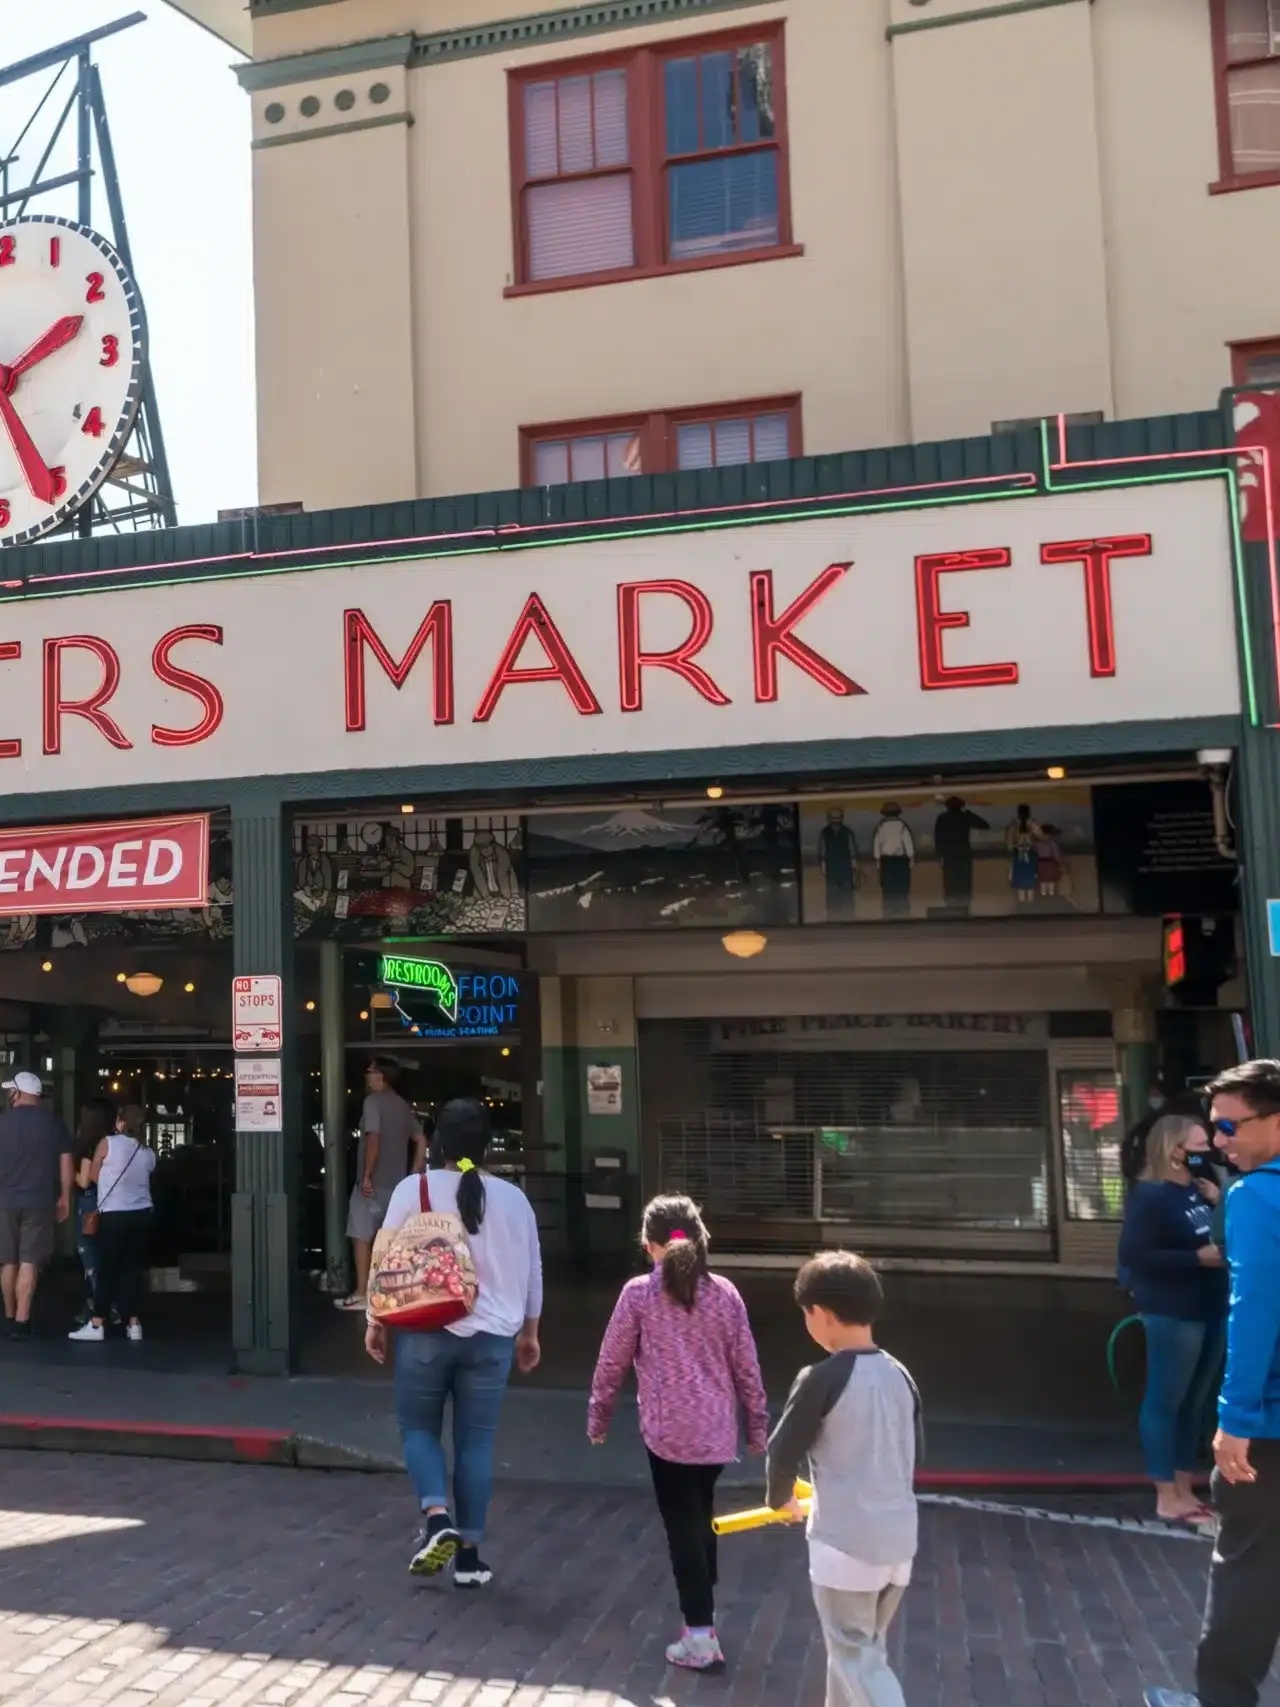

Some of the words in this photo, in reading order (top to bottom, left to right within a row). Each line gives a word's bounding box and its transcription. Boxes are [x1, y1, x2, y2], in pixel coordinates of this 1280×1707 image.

[49, 236, 61, 268] 1
[85, 271, 105, 304] 2
[99, 335, 119, 367] 3
[81, 406, 105, 437] 4
[343, 532, 1153, 733] MARKET
[236, 980, 249, 990] NO
[239, 995, 275, 1007] STOPS
